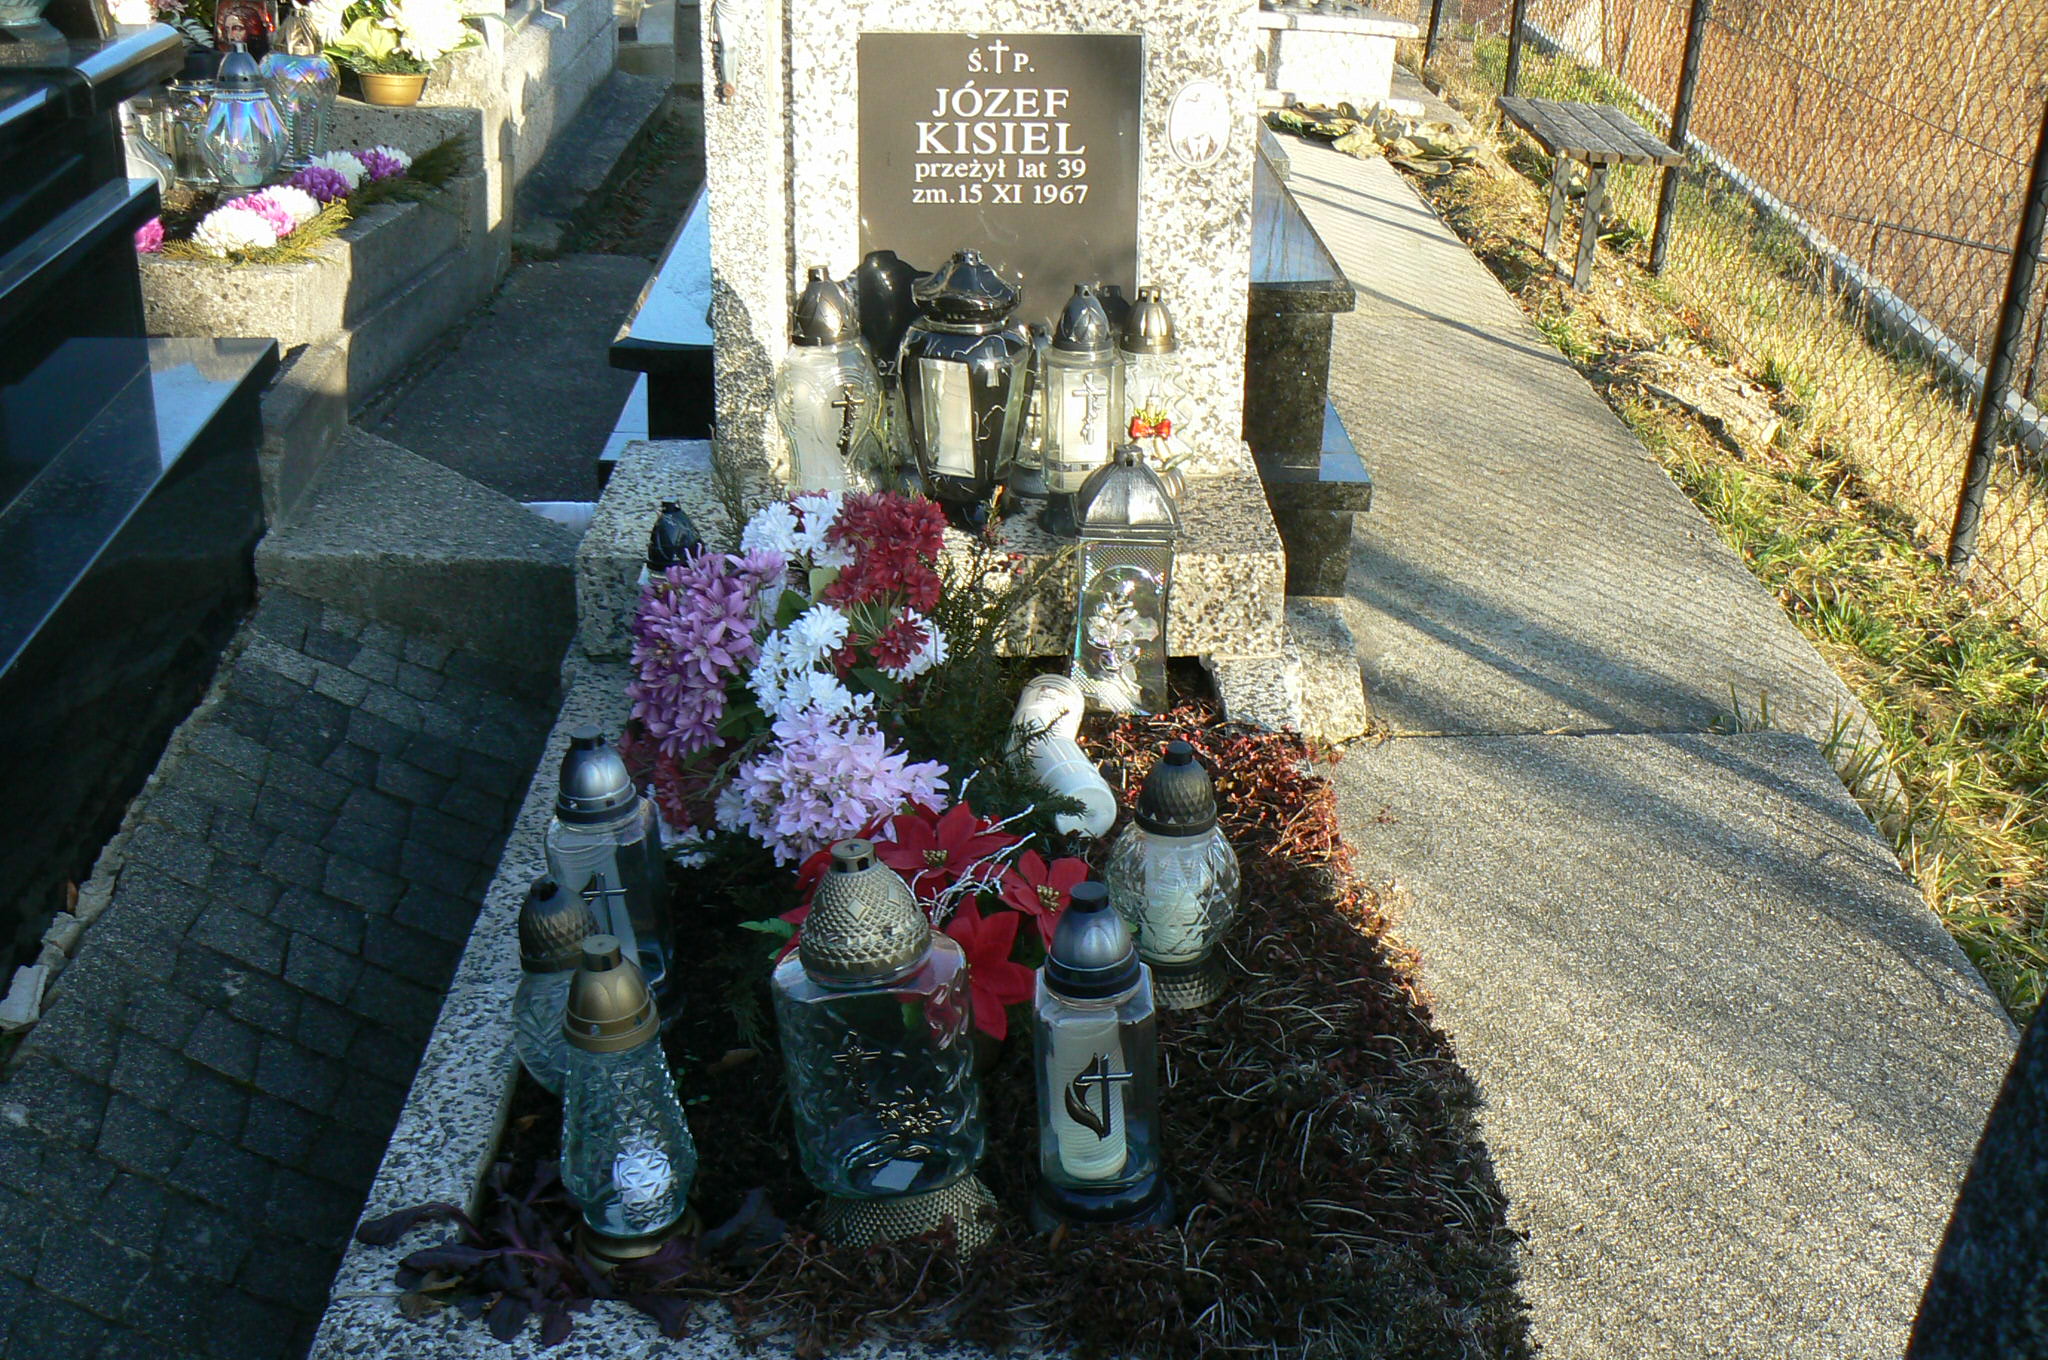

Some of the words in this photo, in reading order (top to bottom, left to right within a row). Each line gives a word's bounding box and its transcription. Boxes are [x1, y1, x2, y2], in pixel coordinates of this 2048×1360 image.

[1013, 52, 1035, 73] P.
[931, 79, 1070, 118] JÓZEF
[914, 121, 1086, 155] KISIEL
[914, 158, 1006, 183] przeżył
[1017, 158, 1047, 179] lat
[1056, 158, 1087, 179] 39
[991, 183, 1023, 204] XI
[1033, 183, 1089, 205] 1967
